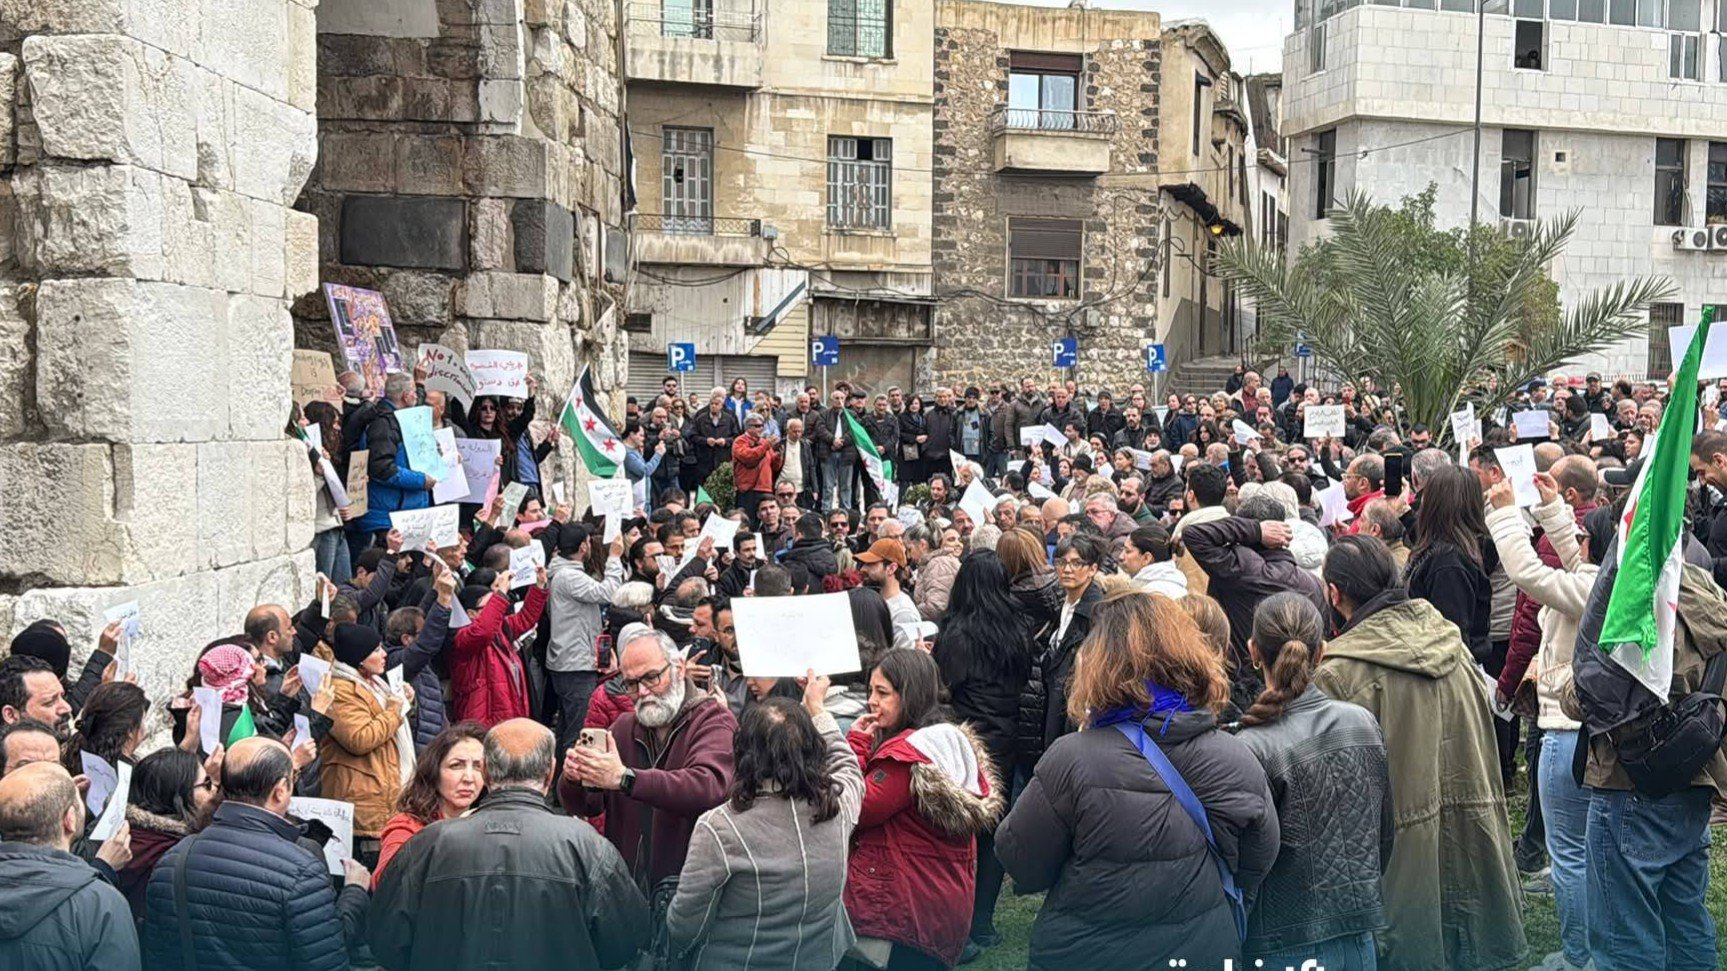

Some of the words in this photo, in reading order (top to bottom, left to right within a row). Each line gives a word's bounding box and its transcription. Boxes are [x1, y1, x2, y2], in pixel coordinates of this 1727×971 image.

[671, 346, 685, 368] P
[812, 341, 824, 362] P
[1053, 343, 1064, 362] P
[1148, 347, 1157, 367] P
